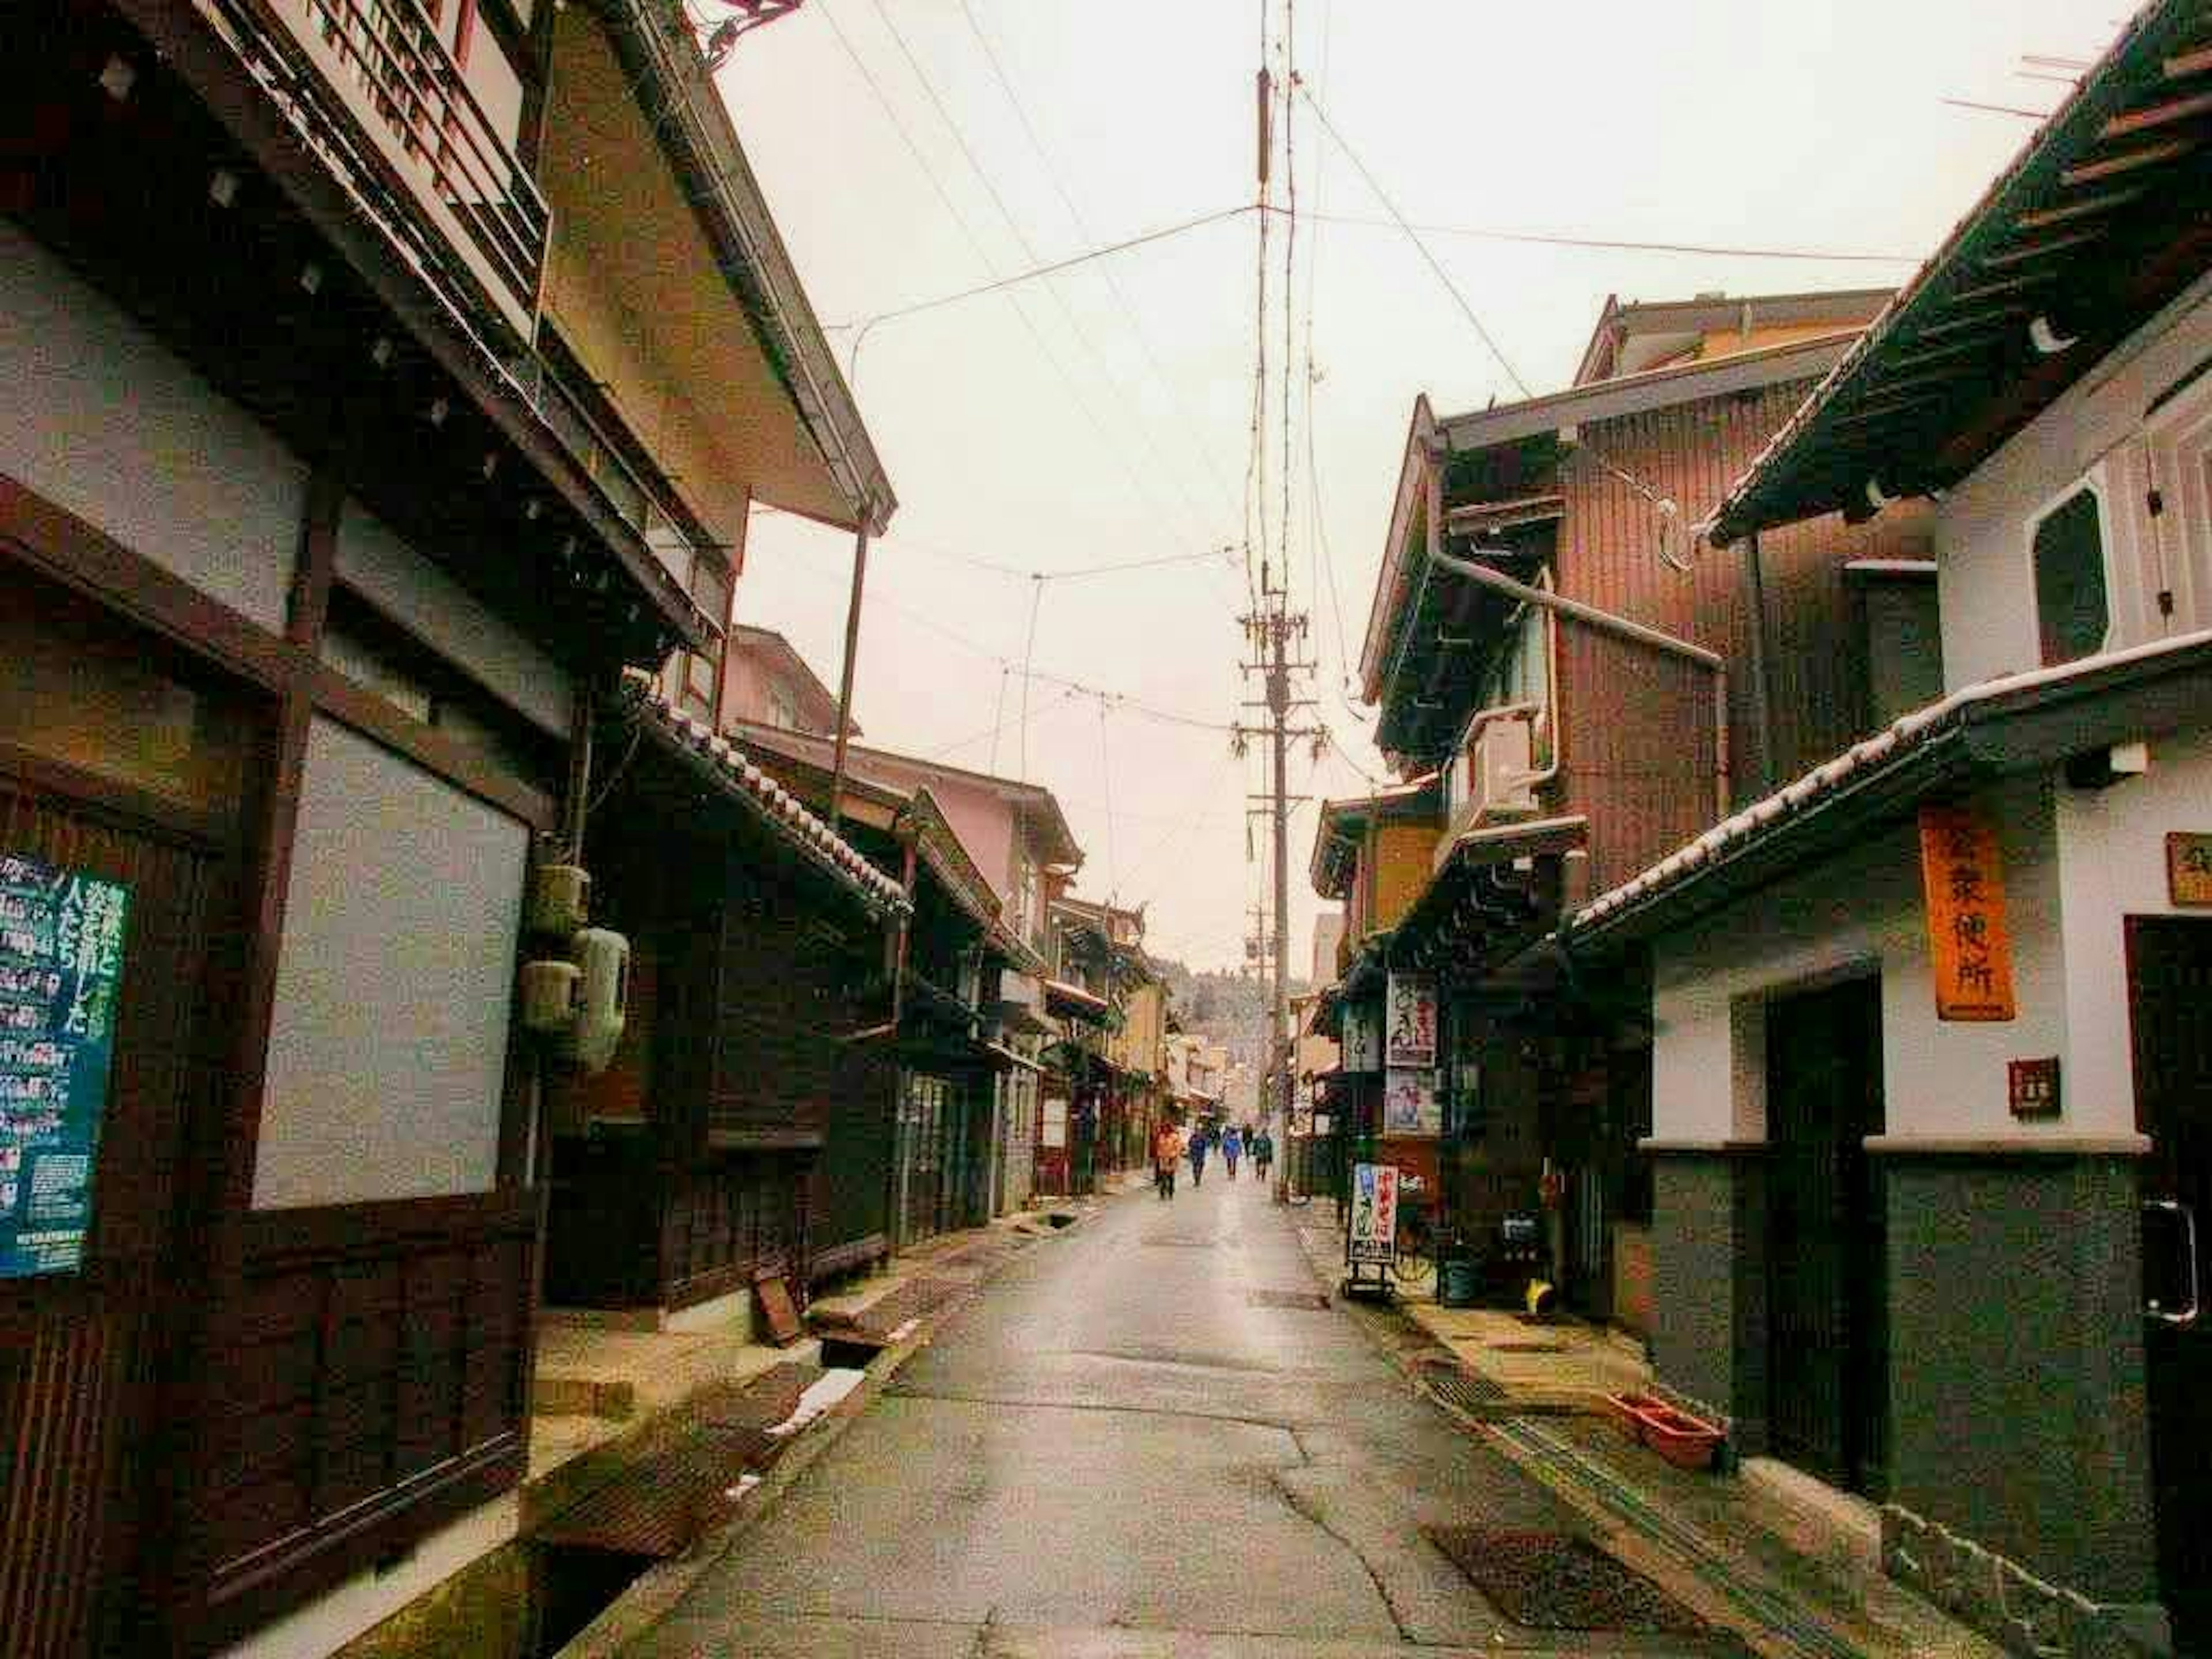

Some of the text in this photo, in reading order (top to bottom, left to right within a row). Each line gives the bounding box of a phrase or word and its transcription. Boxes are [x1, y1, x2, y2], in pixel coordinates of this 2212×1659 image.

[57, 876, 84, 969] 人たち
[1952, 831, 1992, 995] 公衆便所
